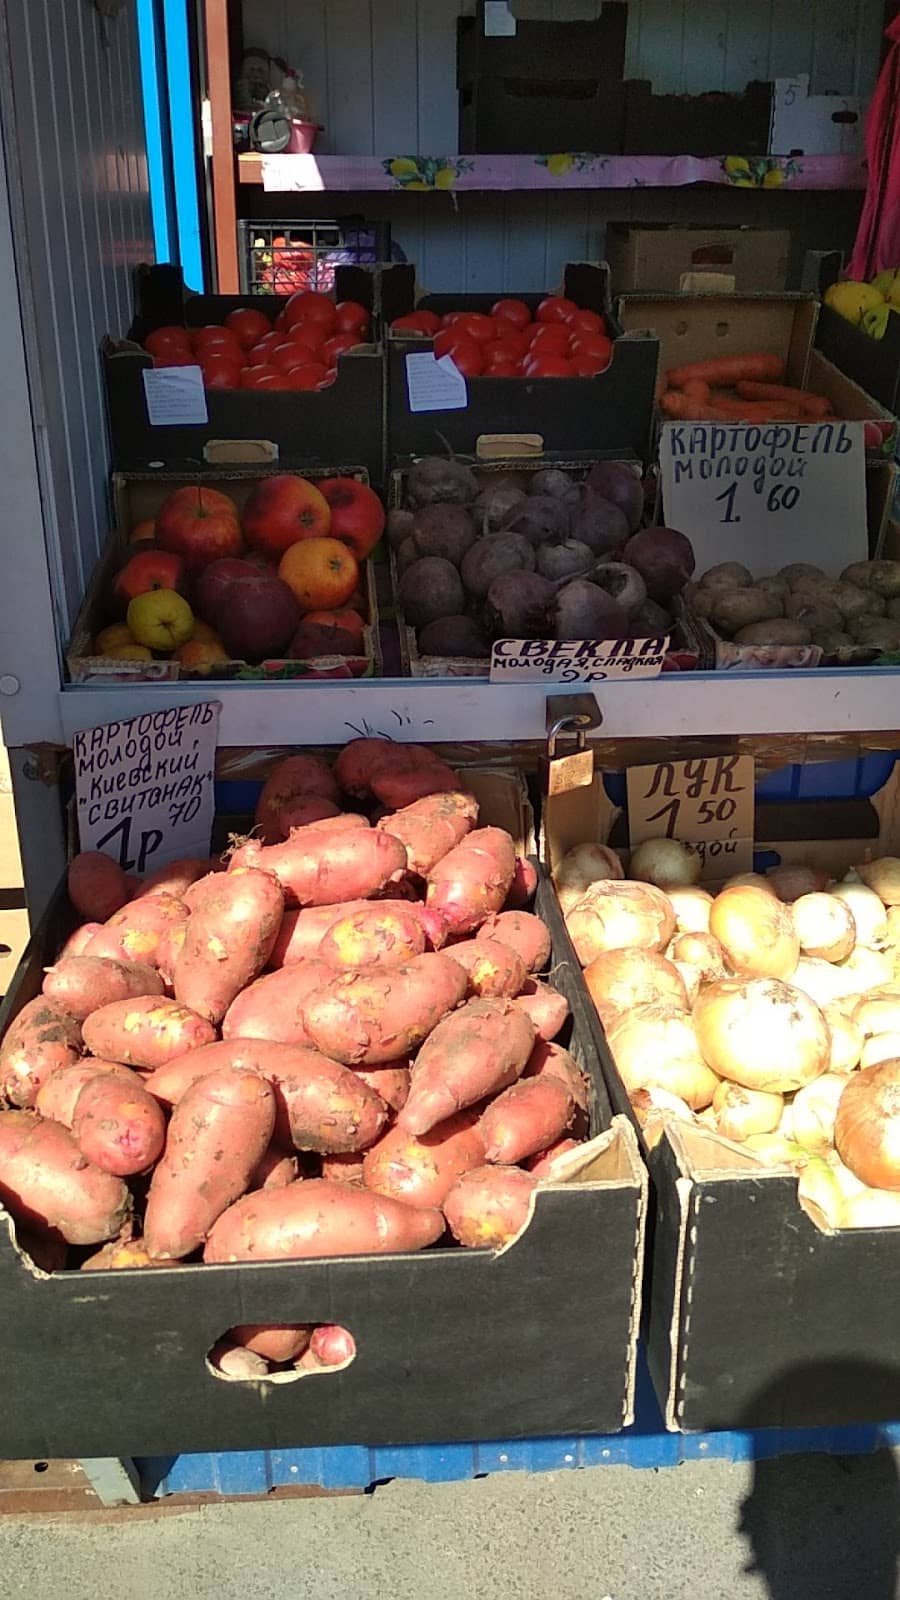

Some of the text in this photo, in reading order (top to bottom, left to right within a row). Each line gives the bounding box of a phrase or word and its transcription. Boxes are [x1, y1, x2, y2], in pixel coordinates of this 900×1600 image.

[671, 423, 852, 459] КАРТОФЕЛЬ
[766, 484, 800, 512] 60
[494, 638, 665, 658] СВЕКЛА
[76, 703, 213, 758] КАРТОФЕЛЬ
[643, 755, 746, 798] ЛУК
[168, 796, 202, 827] 70
[696, 798, 737, 824] 50
